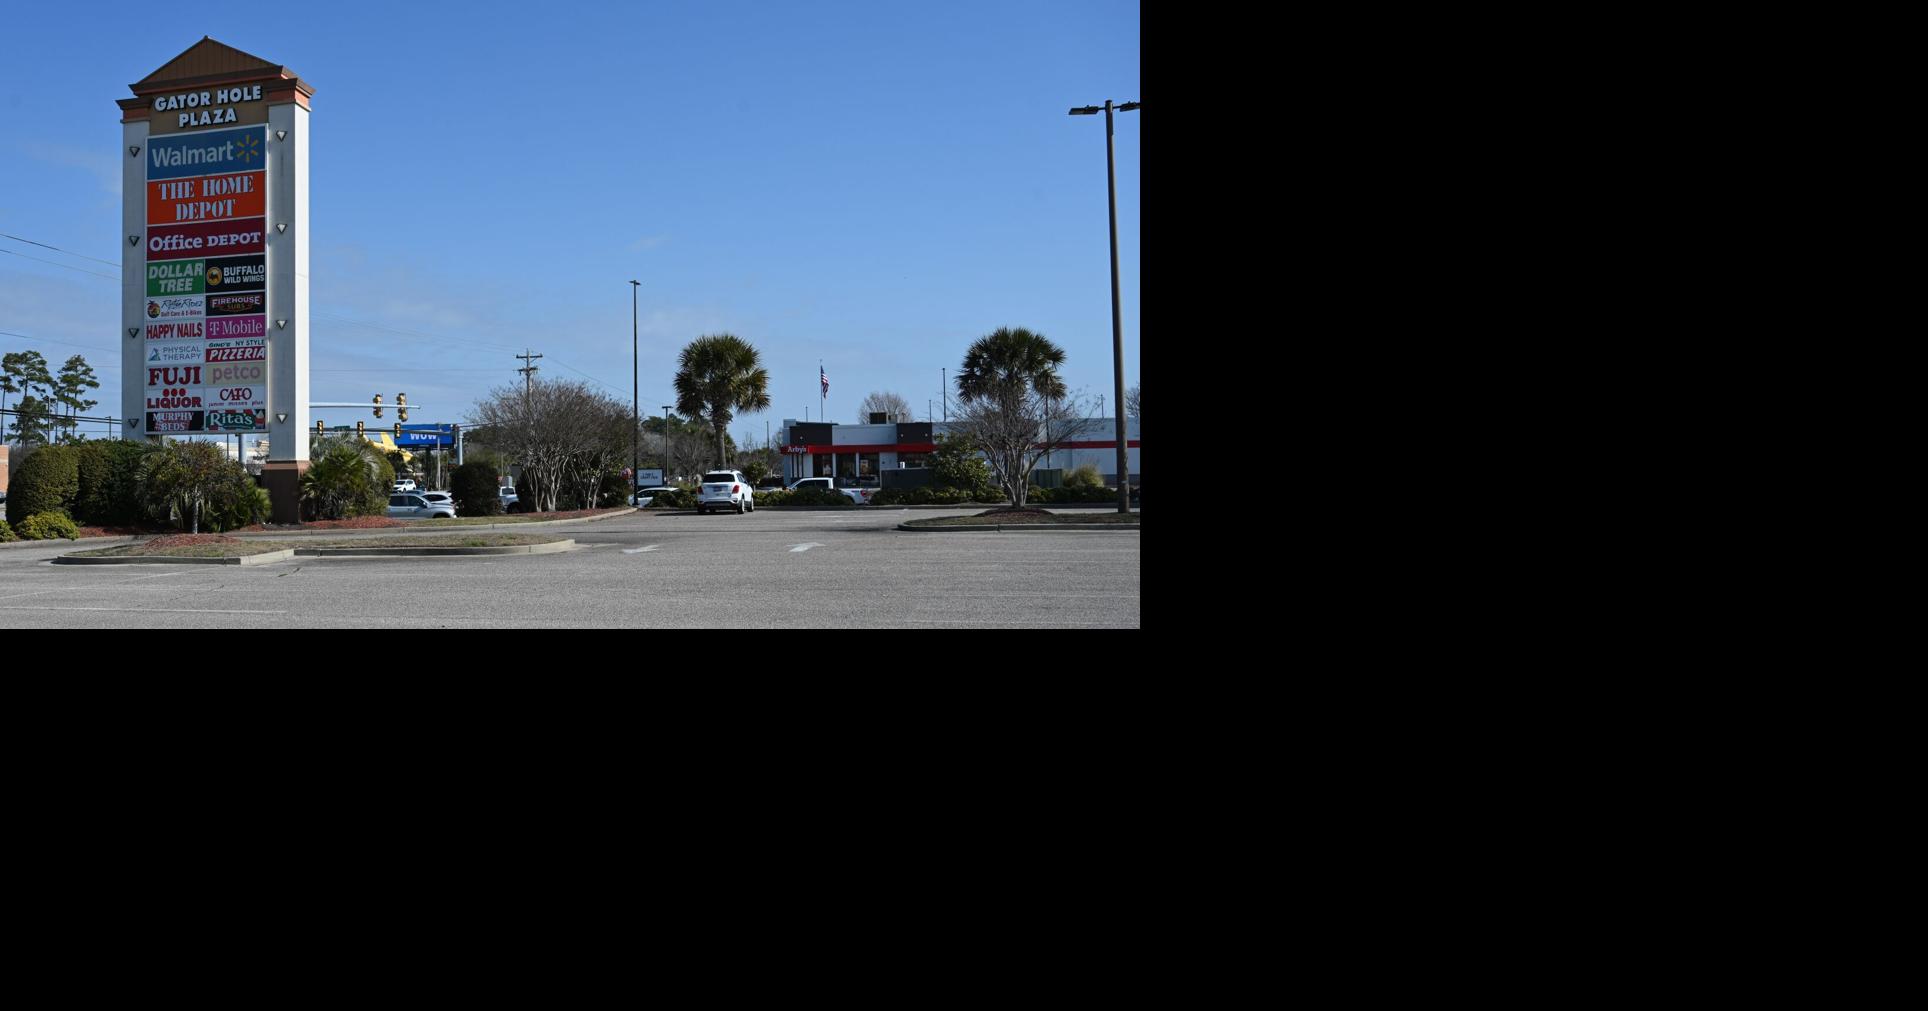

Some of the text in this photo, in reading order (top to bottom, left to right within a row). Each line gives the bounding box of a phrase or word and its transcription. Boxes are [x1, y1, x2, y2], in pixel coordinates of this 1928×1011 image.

[154, 85, 262, 112] GATOR HOLE
[178, 108, 237, 128] PLAZA
[151, 140, 234, 168] Walmart
[158, 175, 254, 200] THE HOME
[175, 199, 236, 221] DEPOT
[150, 231, 261, 252] Office DEPOT
[148, 263, 203, 279] DOLLAR
[223, 264, 265, 277] BUFFALO
[159, 278, 193, 292] TREE
[223, 274, 265, 284] WILD WINGS
[211, 296, 261, 308] FIREHOUSE
[146, 322, 203, 340] HAPPY NAILS
[163, 345, 201, 353] PHYSICAL
[209, 347, 265, 361] PIZZERIA
[163, 353, 201, 361] THERAPY
[148, 366, 202, 386] FUJI
[212, 364, 261, 385] petco
[220, 388, 252, 401] CATO
[146, 397, 202, 409] LIQUOR
[152, 412, 194, 422] MURPHY
[210, 412, 253, 426] Rita's
[161, 422, 186, 431] BEDS
[787, 446, 807, 454] Arby's
